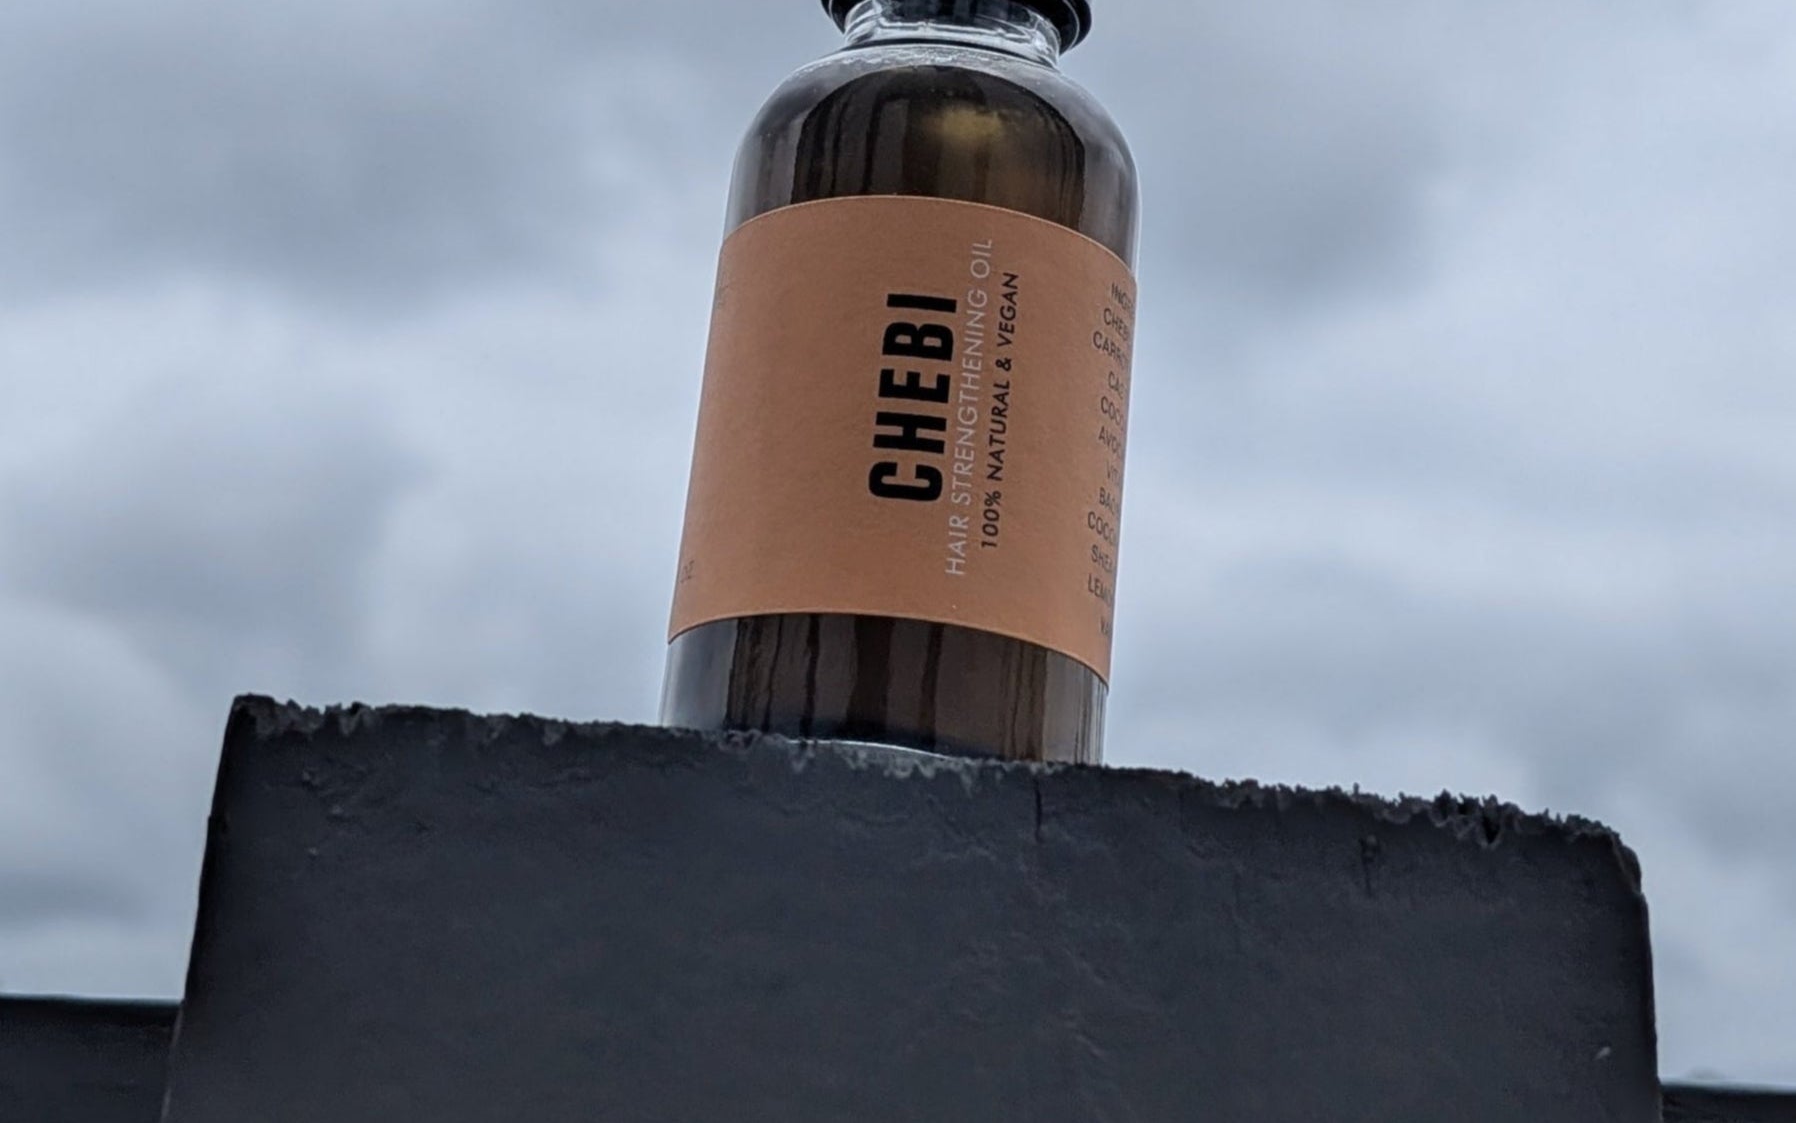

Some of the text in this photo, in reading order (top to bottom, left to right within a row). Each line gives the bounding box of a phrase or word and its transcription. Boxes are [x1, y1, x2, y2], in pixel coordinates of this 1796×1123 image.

[868, 293, 957, 502] CHEBI
[945, 238, 992, 575] HAIR STRENGTHENING OIL
[981, 272, 1019, 549] 100% NATURAL & VEGAN
